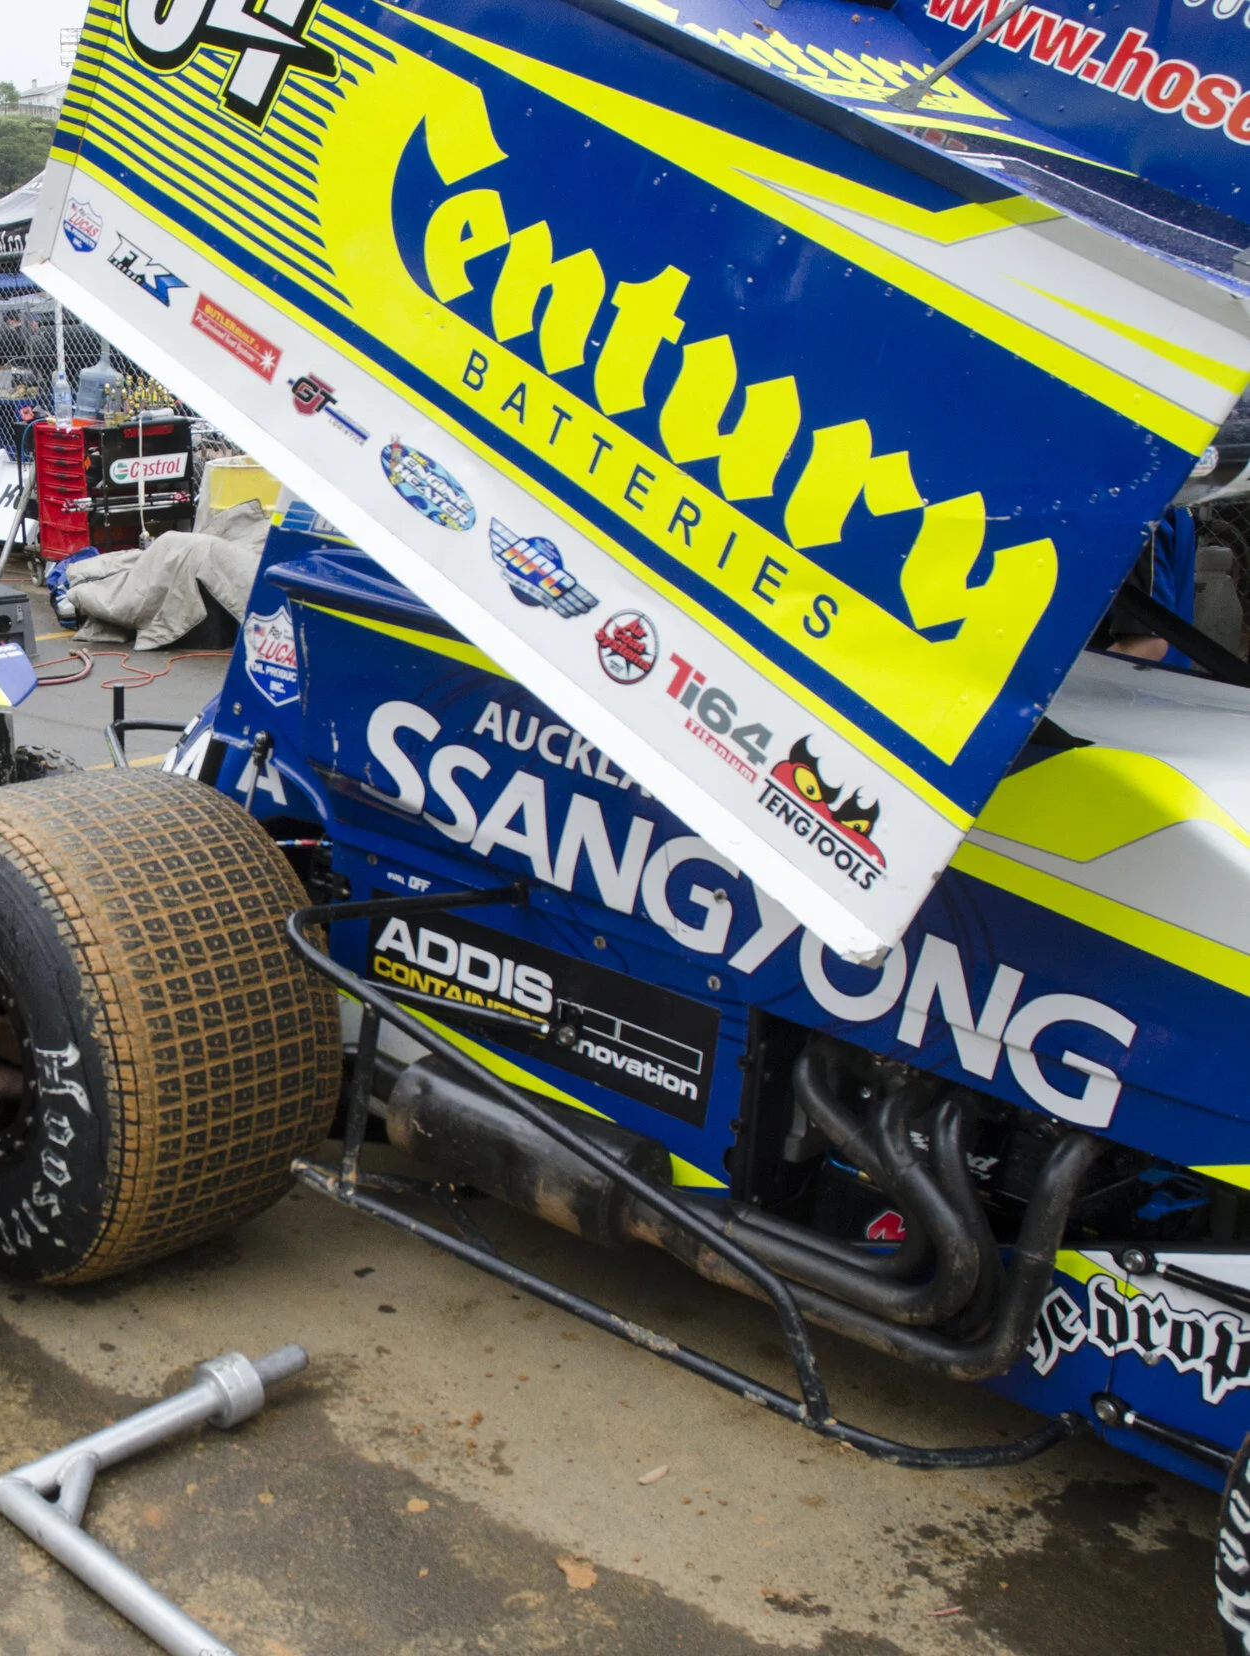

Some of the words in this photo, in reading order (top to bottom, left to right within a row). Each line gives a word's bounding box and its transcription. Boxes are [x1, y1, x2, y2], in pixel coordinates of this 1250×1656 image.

[68, 213, 100, 238] LUCAS
[317, 62, 1059, 764] Century
[129, 456, 182, 479] Castrol
[393, 464, 470, 525] HEATER
[403, 456, 473, 512] ENGINE
[462, 348, 838, 640] BATTERIES
[500, 538, 577, 599] HPC
[665, 652, 774, 766] Ti64
[685, 718, 758, 784] Titanium
[407, 876, 432, 893] OFF
[374, 916, 554, 1015] ADDIS
